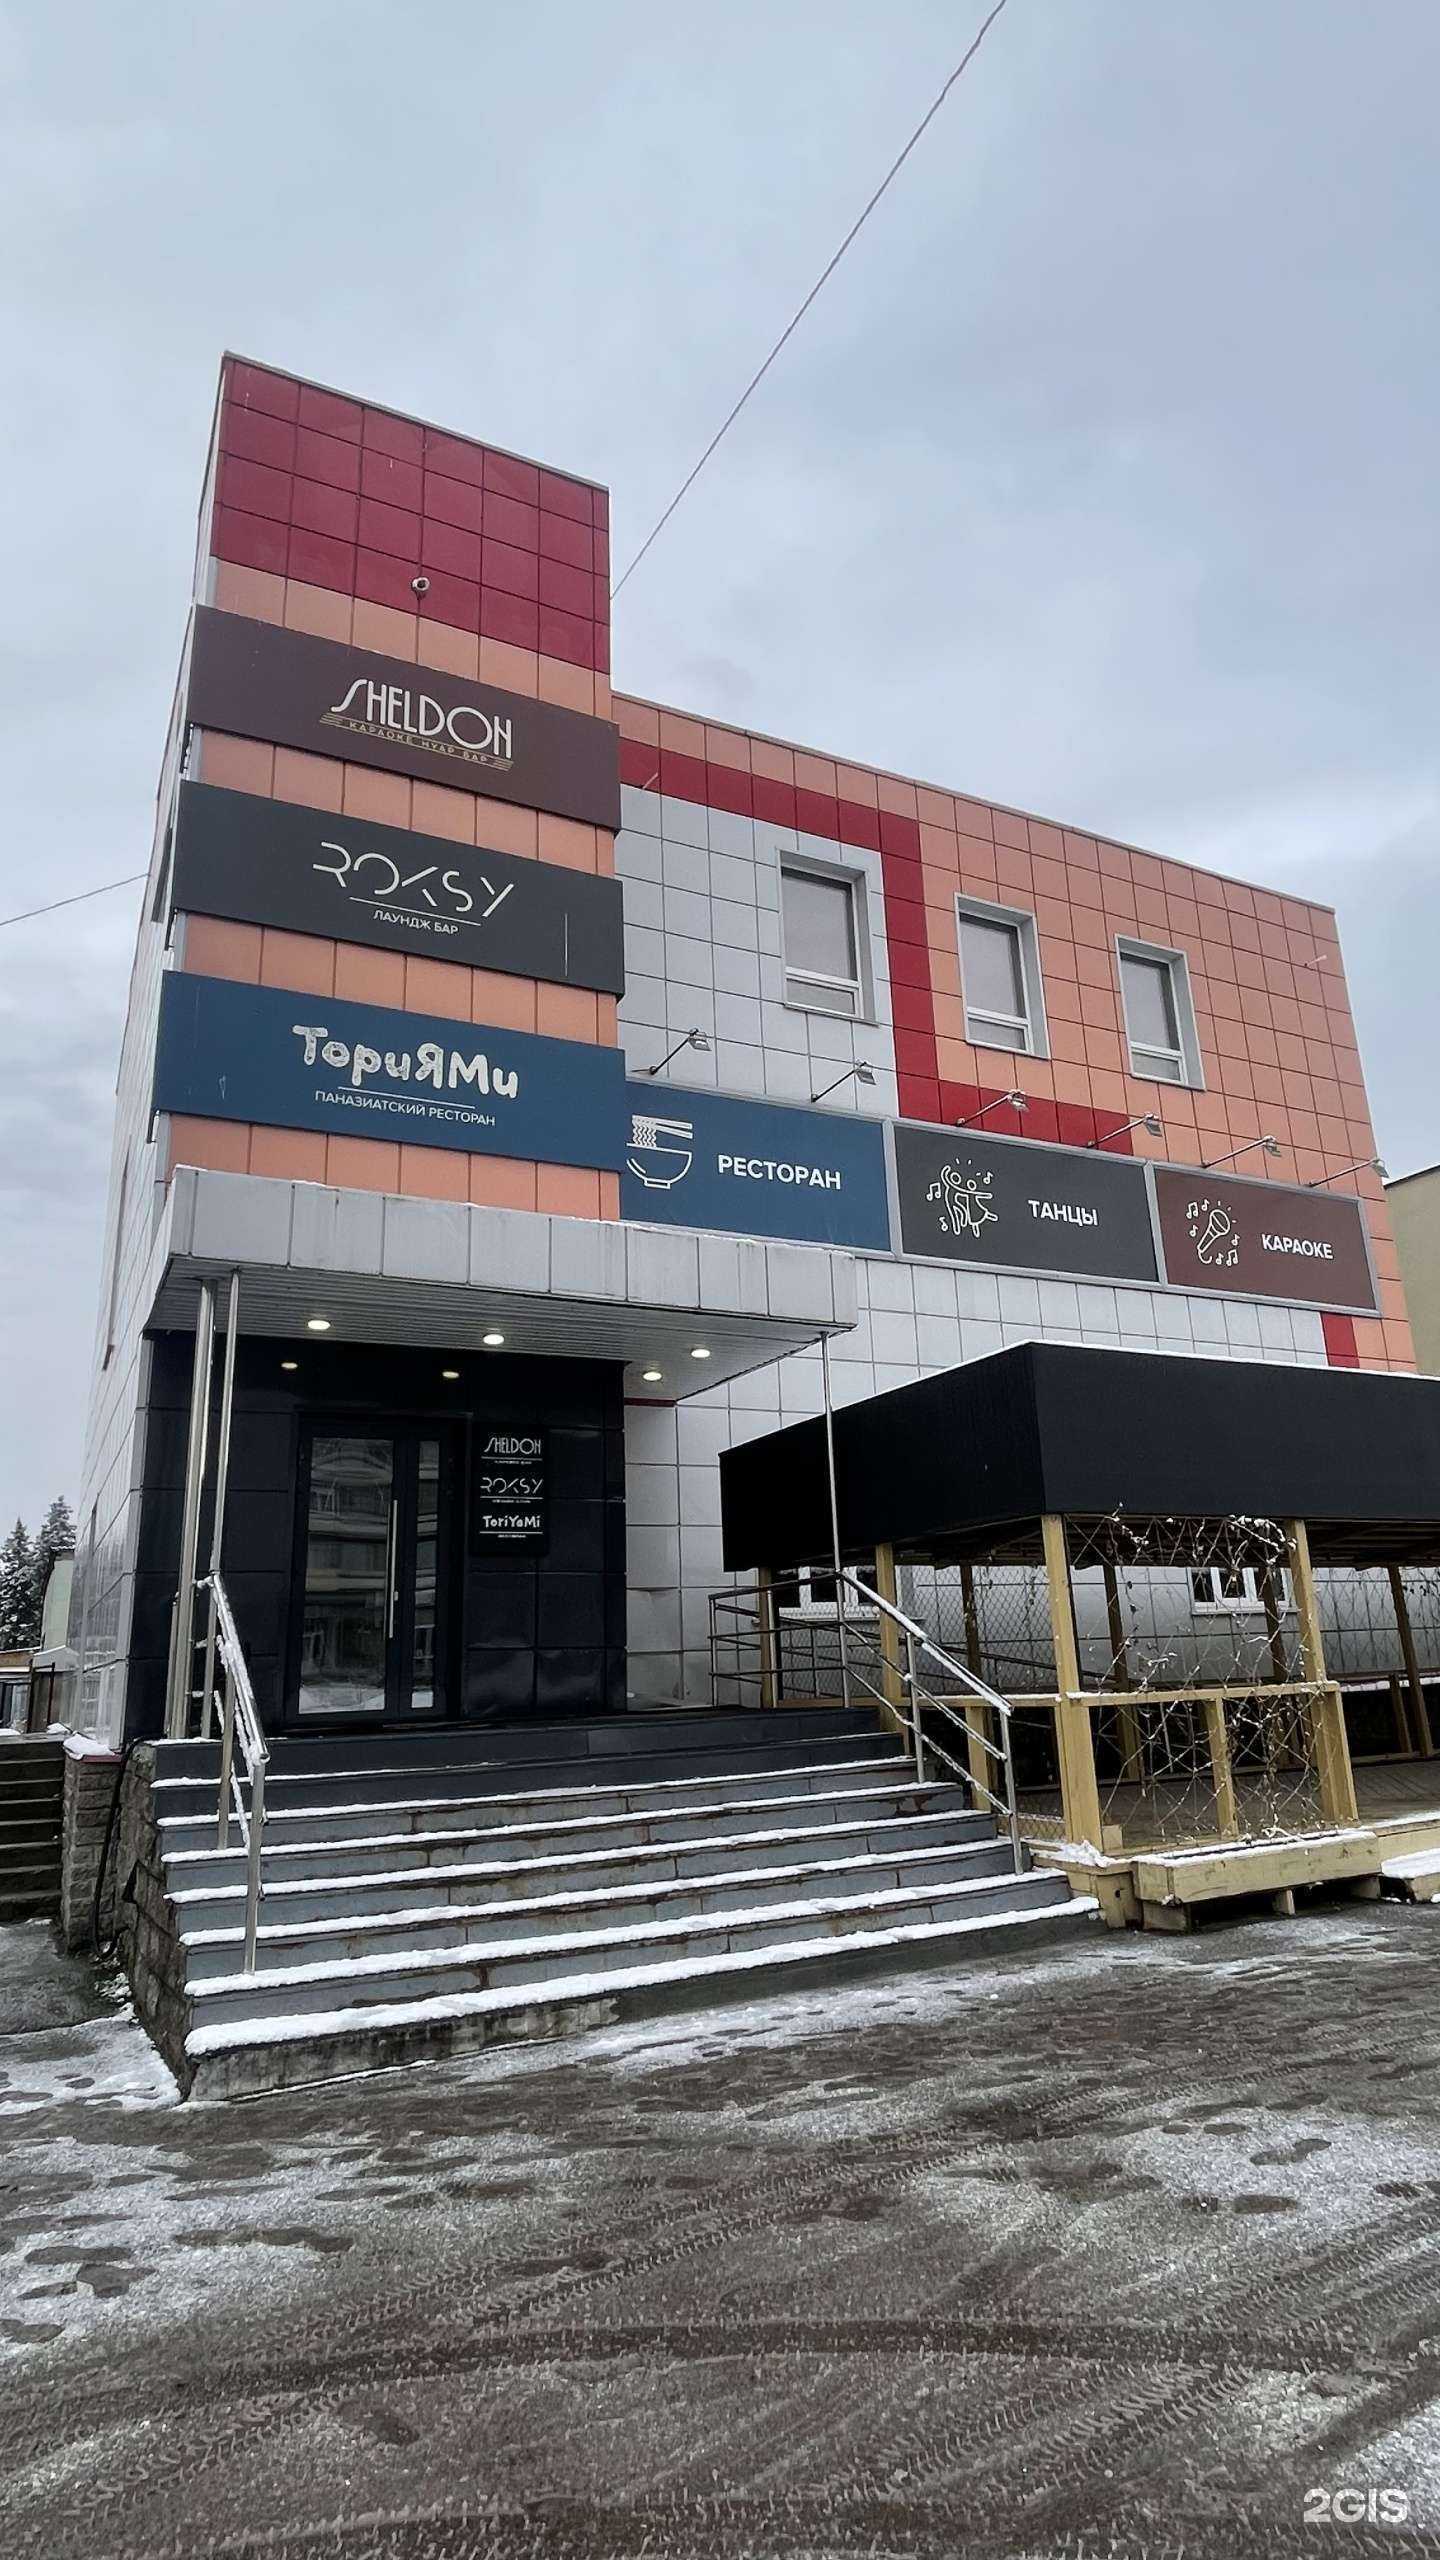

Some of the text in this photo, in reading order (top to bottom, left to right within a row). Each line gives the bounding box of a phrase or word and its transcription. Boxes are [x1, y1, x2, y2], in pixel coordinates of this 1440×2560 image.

[331, 678, 512, 759] SHELDON
[350, 721, 488, 762] КАРАОКЕ НУАР БАР
[312, 841, 515, 918] ROKSY
[373, 909, 459, 935] ЛАУНДЖ БАР
[314, 1090, 496, 1127] ПАНАЗИАТСКИЙ РЕСТОРАН
[718, 1154, 841, 1190] РЕСТОРАН
[1028, 1199, 1098, 1227] ТАНЦЫ
[1261, 1233, 1334, 1260] КАРАОКЕ
[483, 1437, 541, 1455] SHELDON
